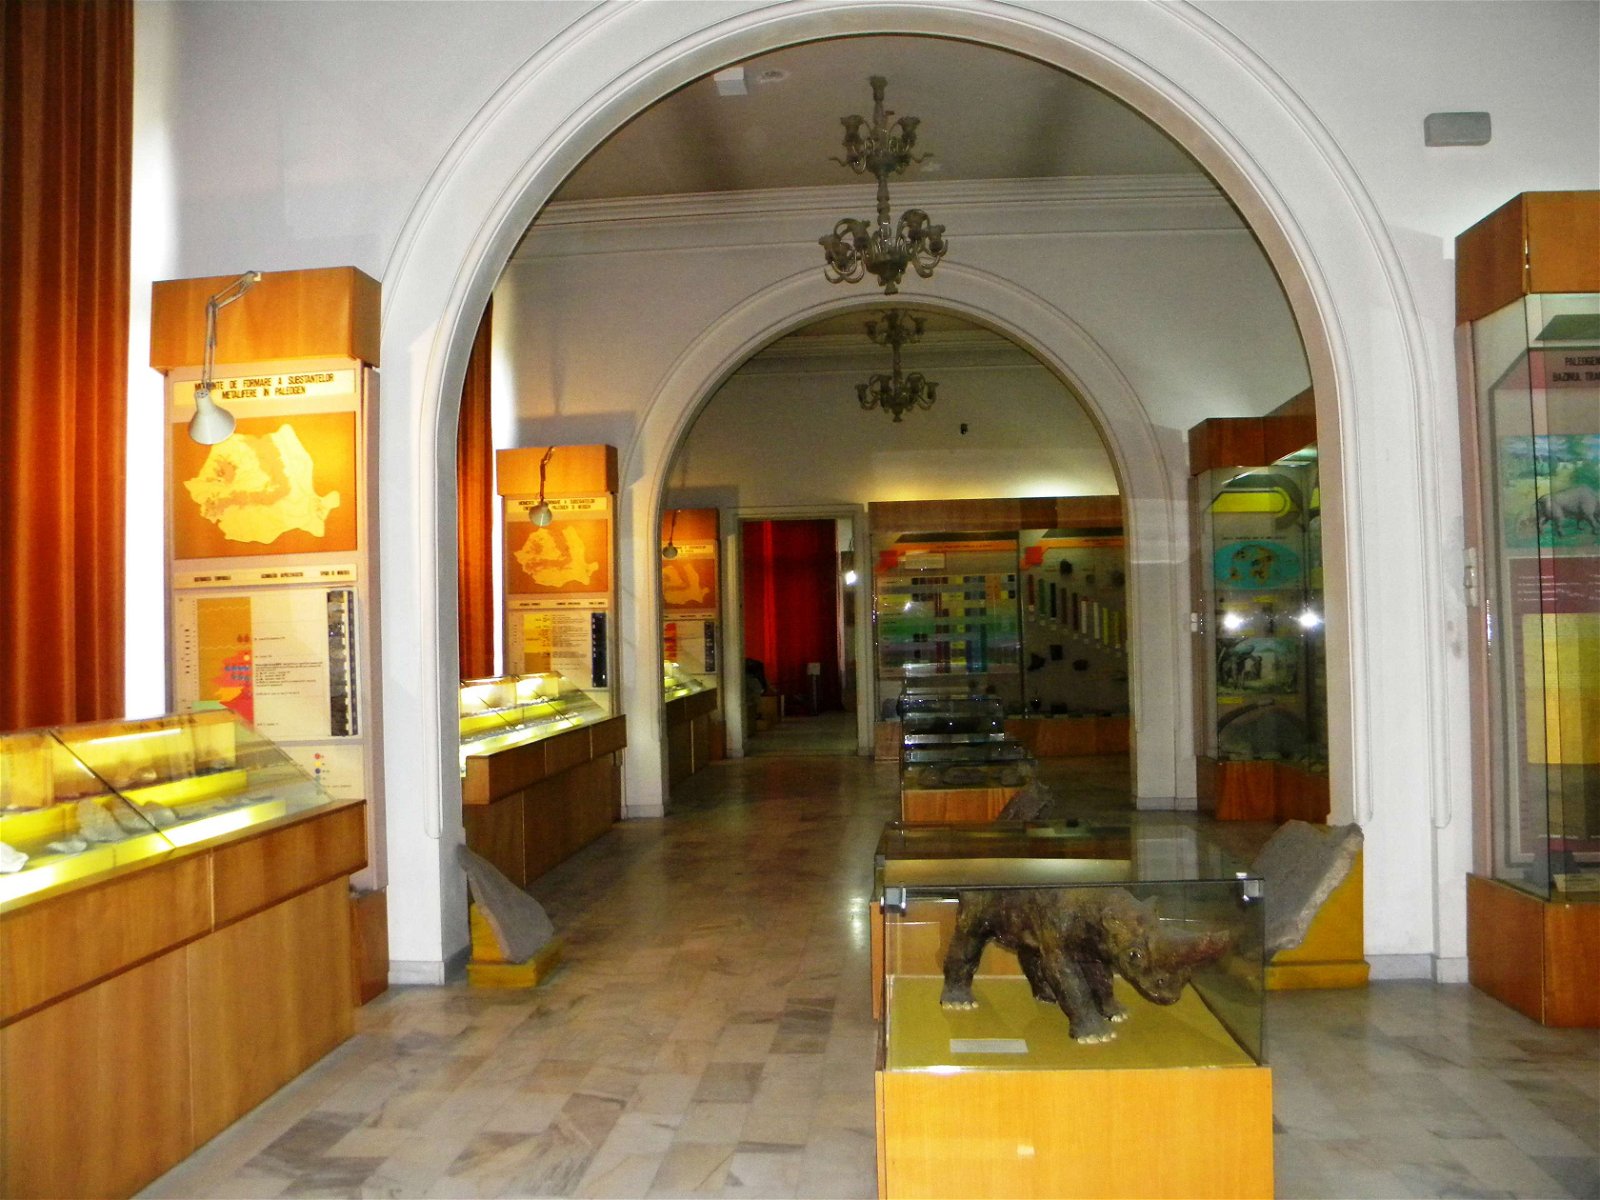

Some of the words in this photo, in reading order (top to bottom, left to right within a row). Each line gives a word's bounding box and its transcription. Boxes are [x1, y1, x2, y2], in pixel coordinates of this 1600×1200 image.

[230, 380, 237, 389] DE
[243, 378, 272, 389] FORMARE
[278, 376, 283, 385] A
[275, 386, 306, 395] PALEOGEN
